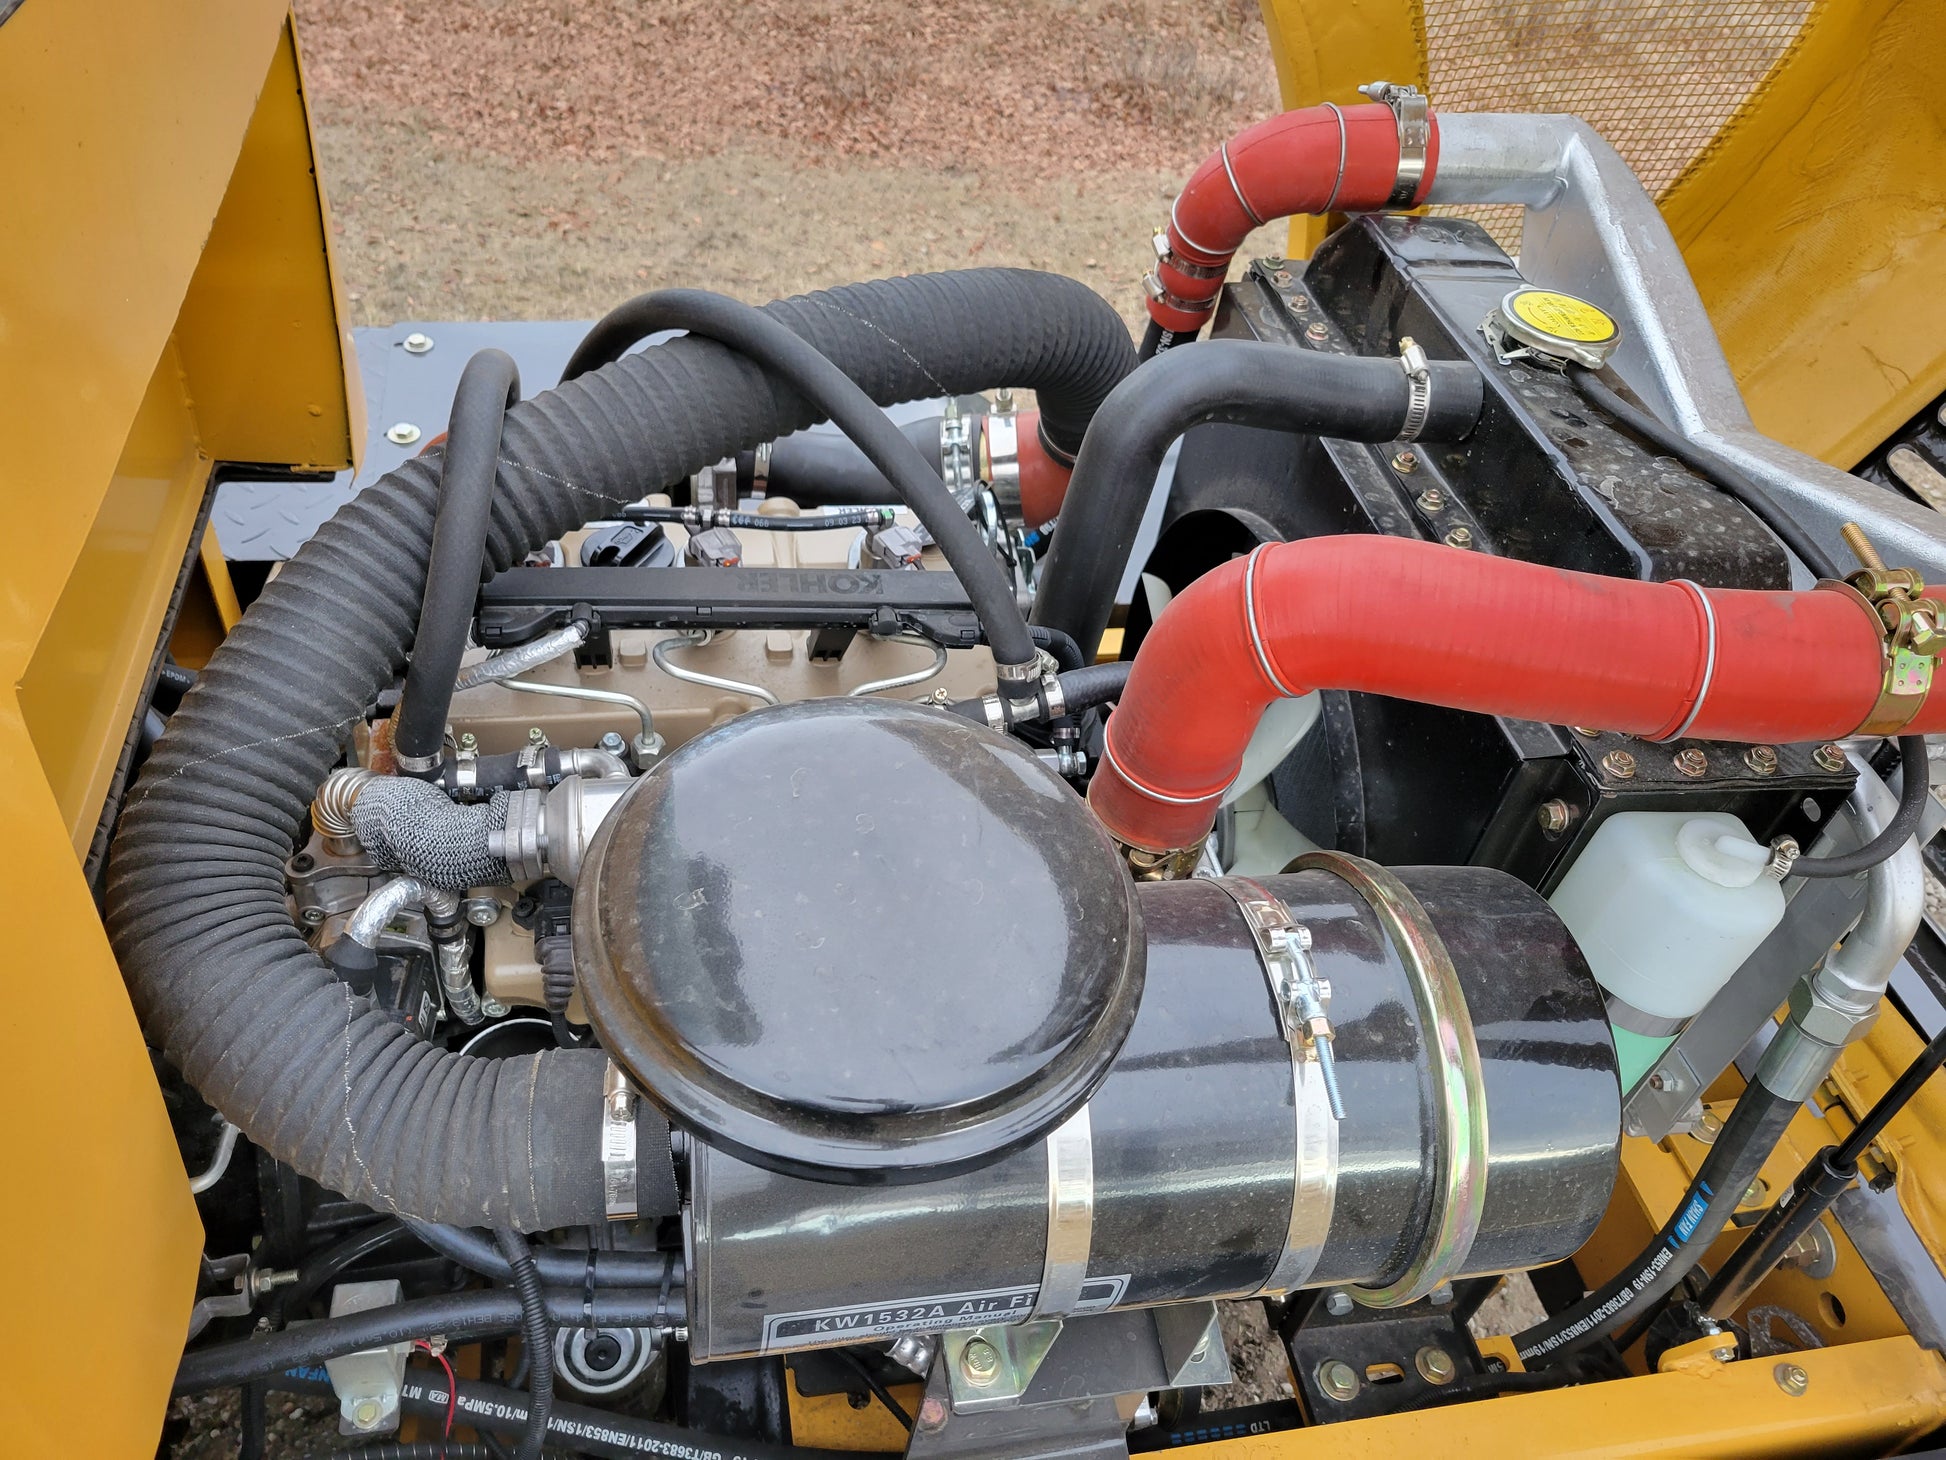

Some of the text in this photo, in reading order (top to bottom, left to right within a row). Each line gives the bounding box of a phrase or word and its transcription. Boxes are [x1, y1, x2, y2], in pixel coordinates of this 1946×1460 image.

[737, 573, 884, 595] KOHLER
[815, 1306, 945, 1332] KW1532A
[957, 1299, 998, 1315] Air
[1009, 1293, 1033, 1309] Fi
[873, 1317, 953, 1332] Operating
[959, 1309, 1017, 1321] Manual
[1249, 1420, 1271, 1434] LTD
